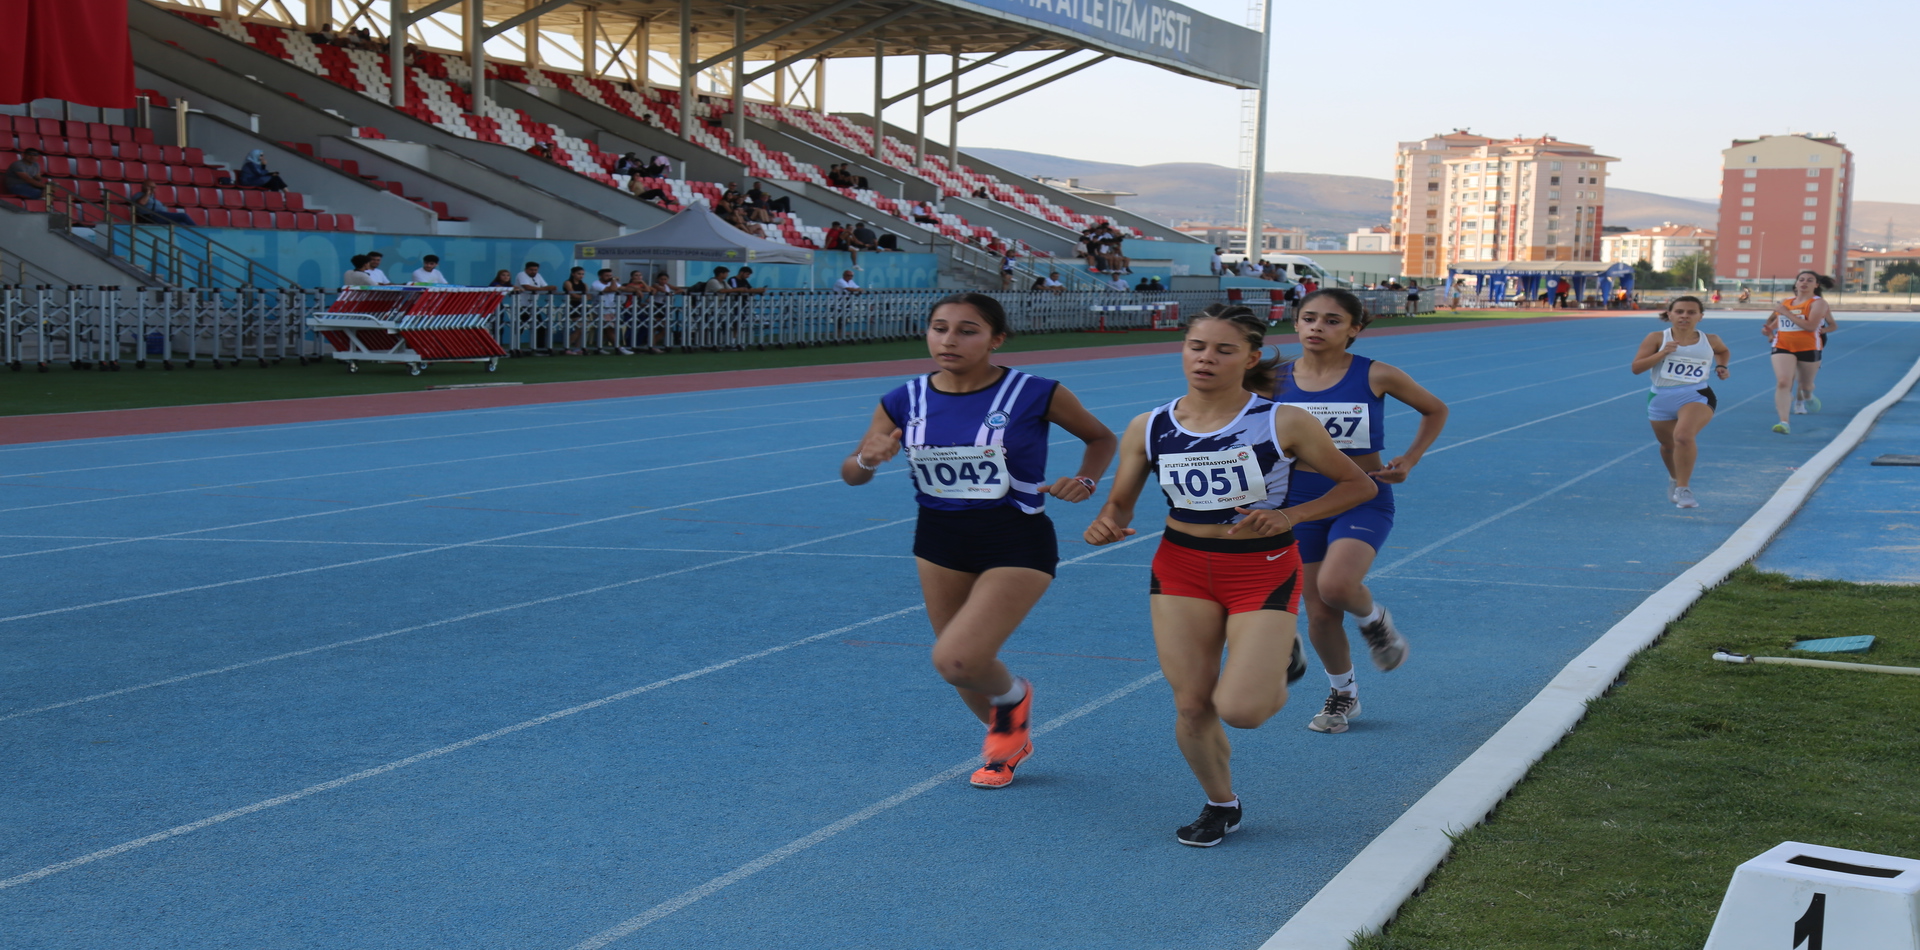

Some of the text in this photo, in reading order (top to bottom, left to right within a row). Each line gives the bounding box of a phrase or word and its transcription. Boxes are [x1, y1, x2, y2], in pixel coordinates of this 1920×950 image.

[1781, 319, 1795, 328] 10
[1667, 362, 1703, 378] 1026
[1318, 417, 1362, 438] 67
[916, 461, 1001, 486] 1042
[1190, 459, 1238, 467] FEDERASYONU
[1169, 465, 1249, 498] 1051
[1792, 892, 1826, 950] 1
